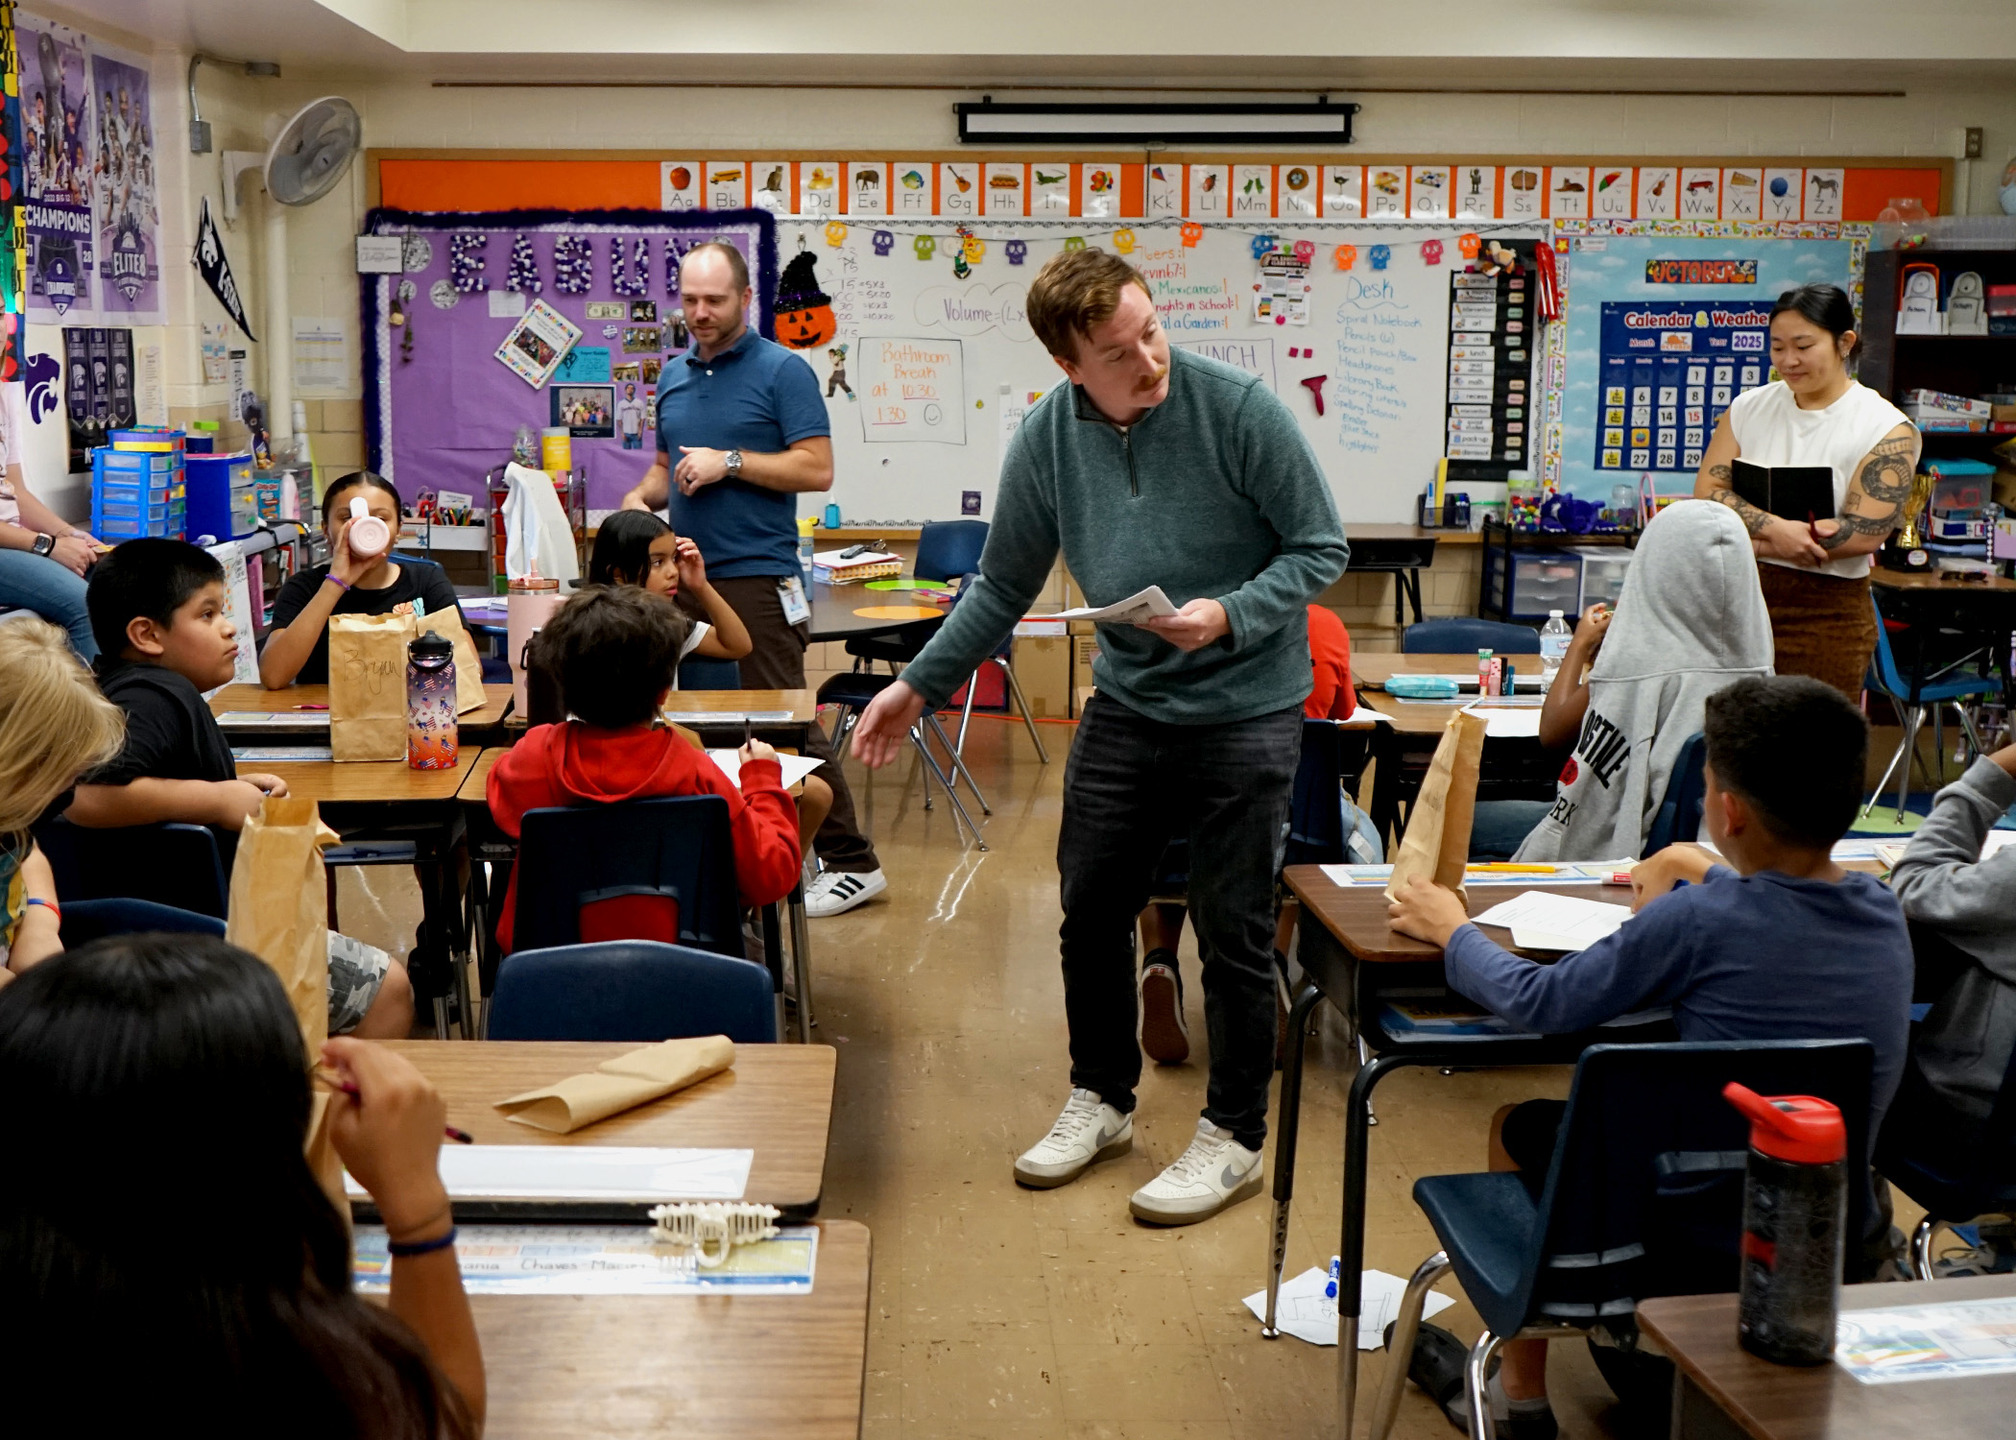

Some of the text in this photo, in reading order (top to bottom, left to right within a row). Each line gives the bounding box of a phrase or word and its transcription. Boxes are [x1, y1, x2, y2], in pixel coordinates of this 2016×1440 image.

[670, 192, 693, 207] Aa
[716, 192, 737, 207] Bb
[810, 193, 831, 208] Dd
[858, 193, 878, 208] Ee
[903, 194, 923, 209] Ff
[947, 194, 971, 215] Gg
[994, 195, 1016, 209] Hh
[1153, 195, 1173, 210] Kk
[1237, 197, 1267, 211] Mm
[1376, 197, 1398, 213] Pp
[1465, 198, 1486, 212] Rr
[1514, 198, 1532, 213] Ss
[1561, 198, 1579, 213] Tt
[1602, 199, 1624, 213] Uu
[1648, 199, 1666, 214] Vv
[1684, 199, 1715, 214] Ww
[1731, 200, 1752, 214] Xx
[1772, 200, 1792, 219] Yy
[1814, 200, 1834, 215] Zz
[26, 204, 91, 234] CHAMPIONS
[83, 250, 92, 263] 28
[113, 251, 139, 276] ELITE
[1652, 261, 1738, 283] OCTOBER
[1346, 275, 1394, 301] Desk
[1174, 320, 1182, 329] a
[1625, 310, 1771, 328] Calendar & Weathe
[1629, 338, 1655, 348] Month
[1709, 337, 1728, 347] Year
[1734, 335, 1762, 348] 2025
[882, 341, 951, 366] Bathroom
[1469, 349, 1487, 357] lunch
[893, 362, 937, 380] Break
[1694, 371, 1699, 381] 1
[1719, 371, 1727, 381] 2
[1747, 371, 1754, 381] 3
[872, 381, 889, 397] at
[1665, 391, 1672, 401] 7
[1691, 391, 1699, 401] 8
[1718, 391, 1725, 401] 9
[1639, 392, 1646, 402] 6
[1661, 411, 1673, 422] 14
[1688, 411, 1700, 422] 15
[1661, 433, 1673, 443] 21
[1687, 433, 1701, 443] 22
[1633, 454, 1647, 464] 27
[1660, 454, 1673, 464] 28
[1686, 454, 1700, 463] 29
[344, 650, 401, 695] Bryan
